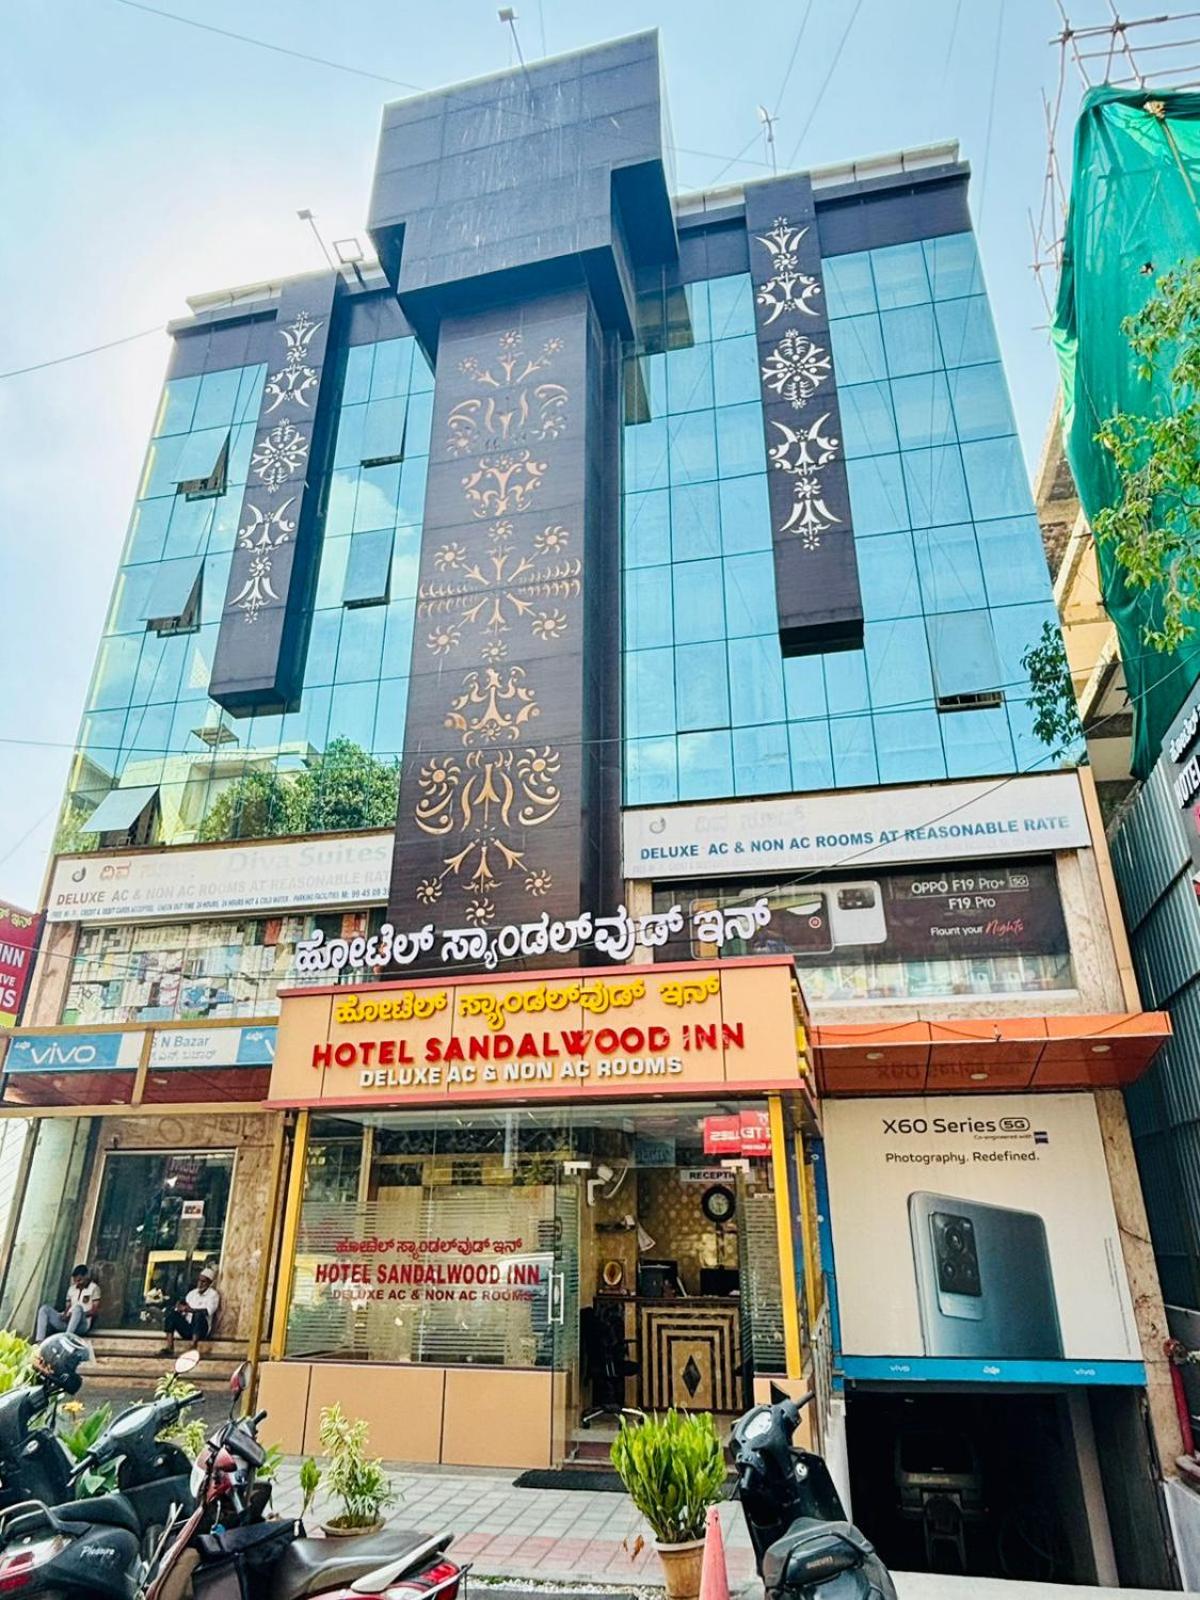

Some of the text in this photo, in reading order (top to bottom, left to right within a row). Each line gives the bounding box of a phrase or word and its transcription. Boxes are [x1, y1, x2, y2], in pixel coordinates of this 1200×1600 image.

[640, 816, 1070, 860] DELUXE AC & NON AC ROOMS AT REASONABLE RATE
[56, 890, 106, 906] DELUXE
[111, 888, 129, 902] AC
[132, 887, 142, 900] &
[146, 885, 174, 899] NON
[177, 884, 196, 897] AC
[199, 877, 246, 896] ROOMS
[272, 871, 361, 890] REASONABLE
[911, 880, 948, 895] OPPO
[952, 879, 975, 891] F19
[979, 877, 1006, 890] Pro+
[949, 896, 997, 910] F19 Pro
[295, 923, 434, 972] ಹೋಟೆಲ್
[693, 897, 772, 948] ಇನ್
[962, 925, 984, 937] your
[334, 991, 448, 1024] ಹೋಟೆಲ್
[659, 975, 721, 1007] ಇನ್
[161, 1035, 171, 1047] N
[174, 1035, 209, 1047] Bazar
[312, 1022, 745, 1068] HOTEL SANDALWOOD INN
[30, 1042, 96, 1064] vivo
[359, 1055, 683, 1088] DELUXE AC & NON AC ROOMS
[882, 1117, 1026, 1134] X60 Series 5G
[885, 1151, 1040, 1165] Photography. Redefined.
[315, 1264, 540, 1285] HOTEL SANDALWOOD INN
[333, 1289, 533, 1300] DELUXE AC & NON AC ROOMS
[889, 1365, 911, 1373] vivo
[1073, 1368, 1096, 1377] vivo
